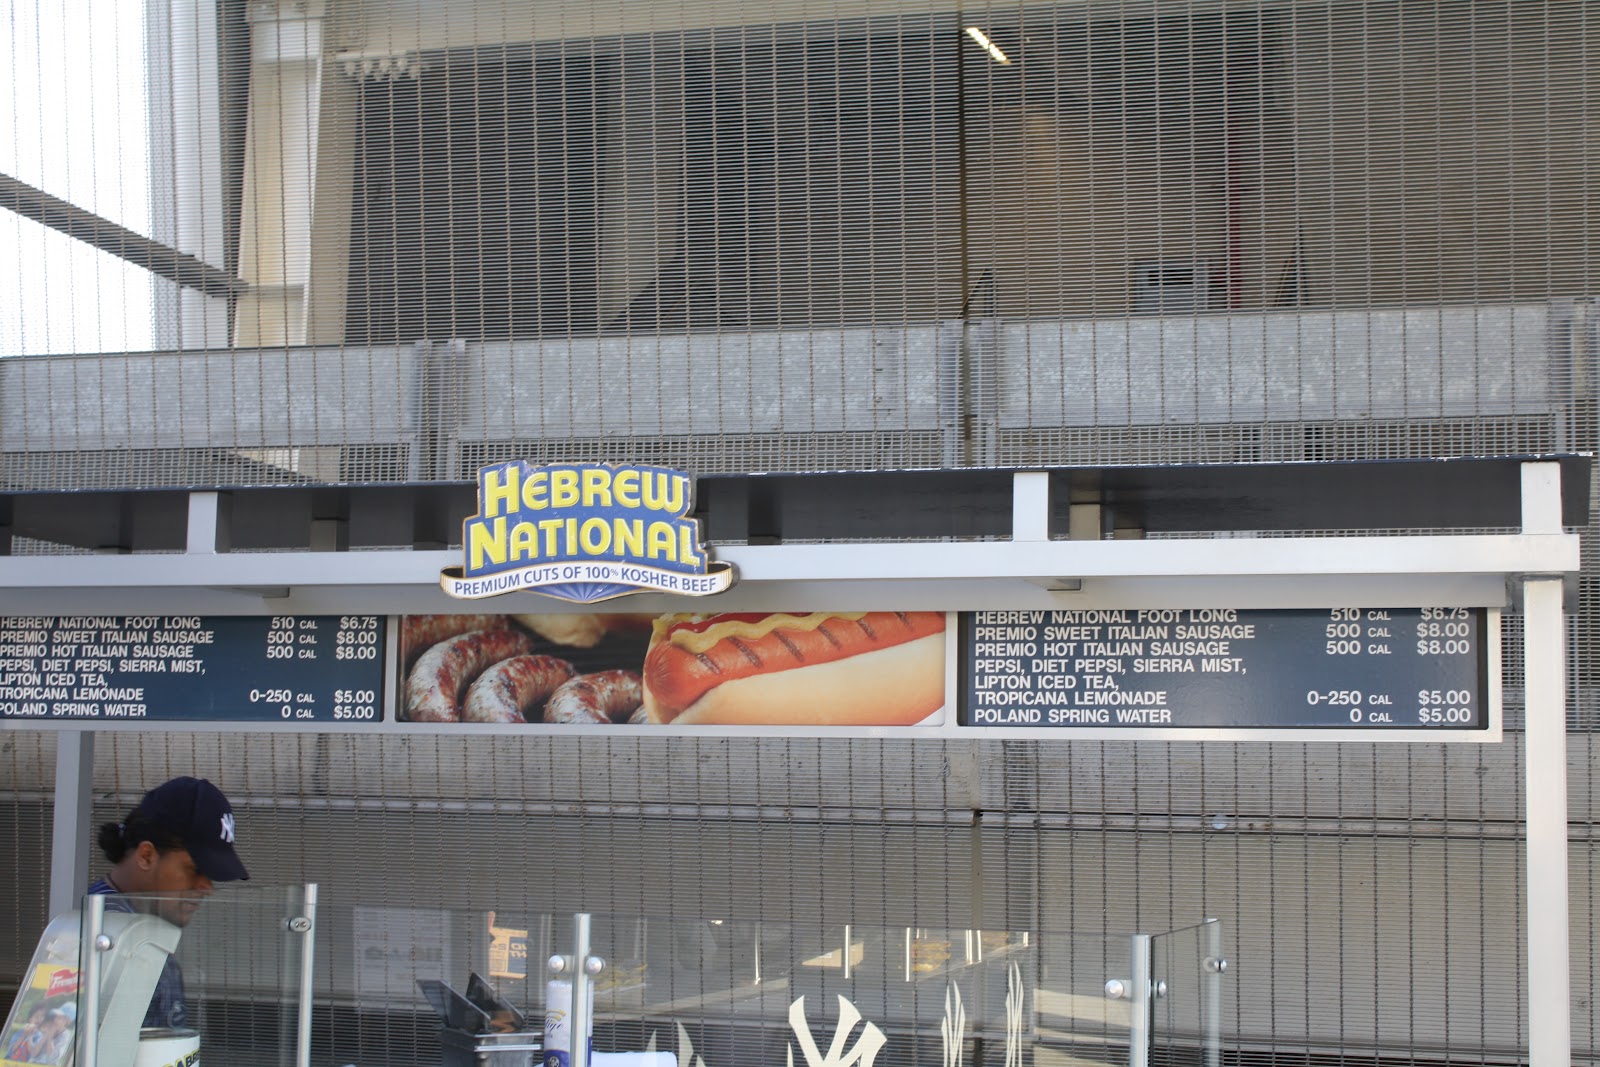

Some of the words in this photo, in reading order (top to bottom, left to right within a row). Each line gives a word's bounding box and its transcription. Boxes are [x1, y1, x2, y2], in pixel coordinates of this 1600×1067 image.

[484, 466, 684, 519] HEBREW
[470, 516, 701, 571] NATIONAL
[454, 574, 520, 596] PREMIUM
[524, 567, 559, 584] CUTS
[562, 567, 582, 580] OF
[585, 566, 619, 580] 100%
[621, 568, 679, 589] KOSHER
[681, 577, 717, 592] BEEF
[975, 610, 1045, 625] HEBREW
[1051, 610, 1131, 625] NATIONAL
[1137, 609, 1183, 625] FOOT
[1190, 609, 1237, 625] LONG
[1330, 608, 1361, 622] 510
[1367, 610, 1392, 622] CAL
[1420, 608, 1470, 622] $6.75
[1, 617, 54, 629] HEBREW
[59, 617, 119, 629] NATIONAL
[125, 617, 159, 629] FOOT
[164, 617, 201, 629] LONG
[271, 617, 295, 630] 510
[300, 620, 318, 630] CAL
[340, 617, 378, 630] $6.75
[1325, 623, 1361, 638] 500
[1367, 628, 1392, 638] CAL
[1416, 622, 1470, 639] $8.00
[0, 631, 48, 644] PREMIO
[52, 631, 97, 644] SWEET
[101, 631, 147, 644] ITALIAN
[152, 631, 214, 644] SAUSAGE
[267, 631, 295, 644] 500
[299, 635, 318, 644] CAL
[336, 631, 377, 645] $8.00
[975, 625, 1037, 641] PREMIO
[1043, 625, 1102, 641] SWEET
[1108, 625, 1168, 641] ITALIAN
[1175, 625, 1255, 641] SAUSAGE
[0, 645, 47, 658] PREMIO
[51, 645, 78, 658] HOT
[81, 645, 128, 658] ITALIAN
[132, 645, 194, 658] SAUSAGE
[266, 645, 294, 659] 500
[298, 649, 317, 659] CAL
[335, 646, 377, 661] $8.00
[975, 642, 1037, 657] PREMIO
[1043, 642, 1077, 657] HOT
[1083, 642, 1143, 657] ITALIAN
[1150, 642, 1230, 657] SAUSAGE
[1325, 640, 1361, 655] 500
[1367, 645, 1392, 655] CAL
[1416, 639, 1470, 656] $8.00
[0, 659, 37, 673] PEPSI,
[41, 659, 71, 673] DIET
[75, 659, 114, 673] PEPSI,
[119, 659, 167, 673] SIERRA
[171, 659, 206, 674] MIST,
[975, 658, 1026, 675] PEPSI,
[1031, 658, 1068, 675] DIET
[1074, 658, 1127, 675] PEPSI,
[1133, 658, 1195, 675] SIERRA
[1201, 658, 1248, 675] MIST,
[0, 673, 41, 687] LIPTON
[45, 673, 76, 687] ICED
[80, 673, 108, 688] TEA,
[974, 674, 1031, 691] LIPTON
[1037, 674, 1077, 691] ICED
[1083, 674, 1120, 691] TEA,
[0, 687, 68, 700] TROPICANA
[73, 687, 144, 700] LEMONADE
[250, 689, 292, 704] 0-250
[296, 693, 315, 703] CAL
[334, 689, 375, 704] $5.00
[975, 691, 1068, 706] TROPICANA
[1074, 691, 1167, 706] LEMONADE
[1306, 690, 1362, 706] 0-250
[1368, 695, 1393, 706] CAL
[1418, 690, 1471, 706] $5.00
[52, 702, 100, 717] SPRING
[104, 702, 147, 717] WATER
[281, 705, 291, 719] 0
[295, 709, 315, 719] CAL
[333, 705, 375, 720] $5.00
[974, 708, 1042, 724] POLAND
[1047, 708, 1110, 724] SPRING
[1116, 709, 1172, 724] WATER
[1349, 707, 1362, 723] 0
[1368, 712, 1393, 723] CAL
[1418, 707, 1471, 724] $5.00
